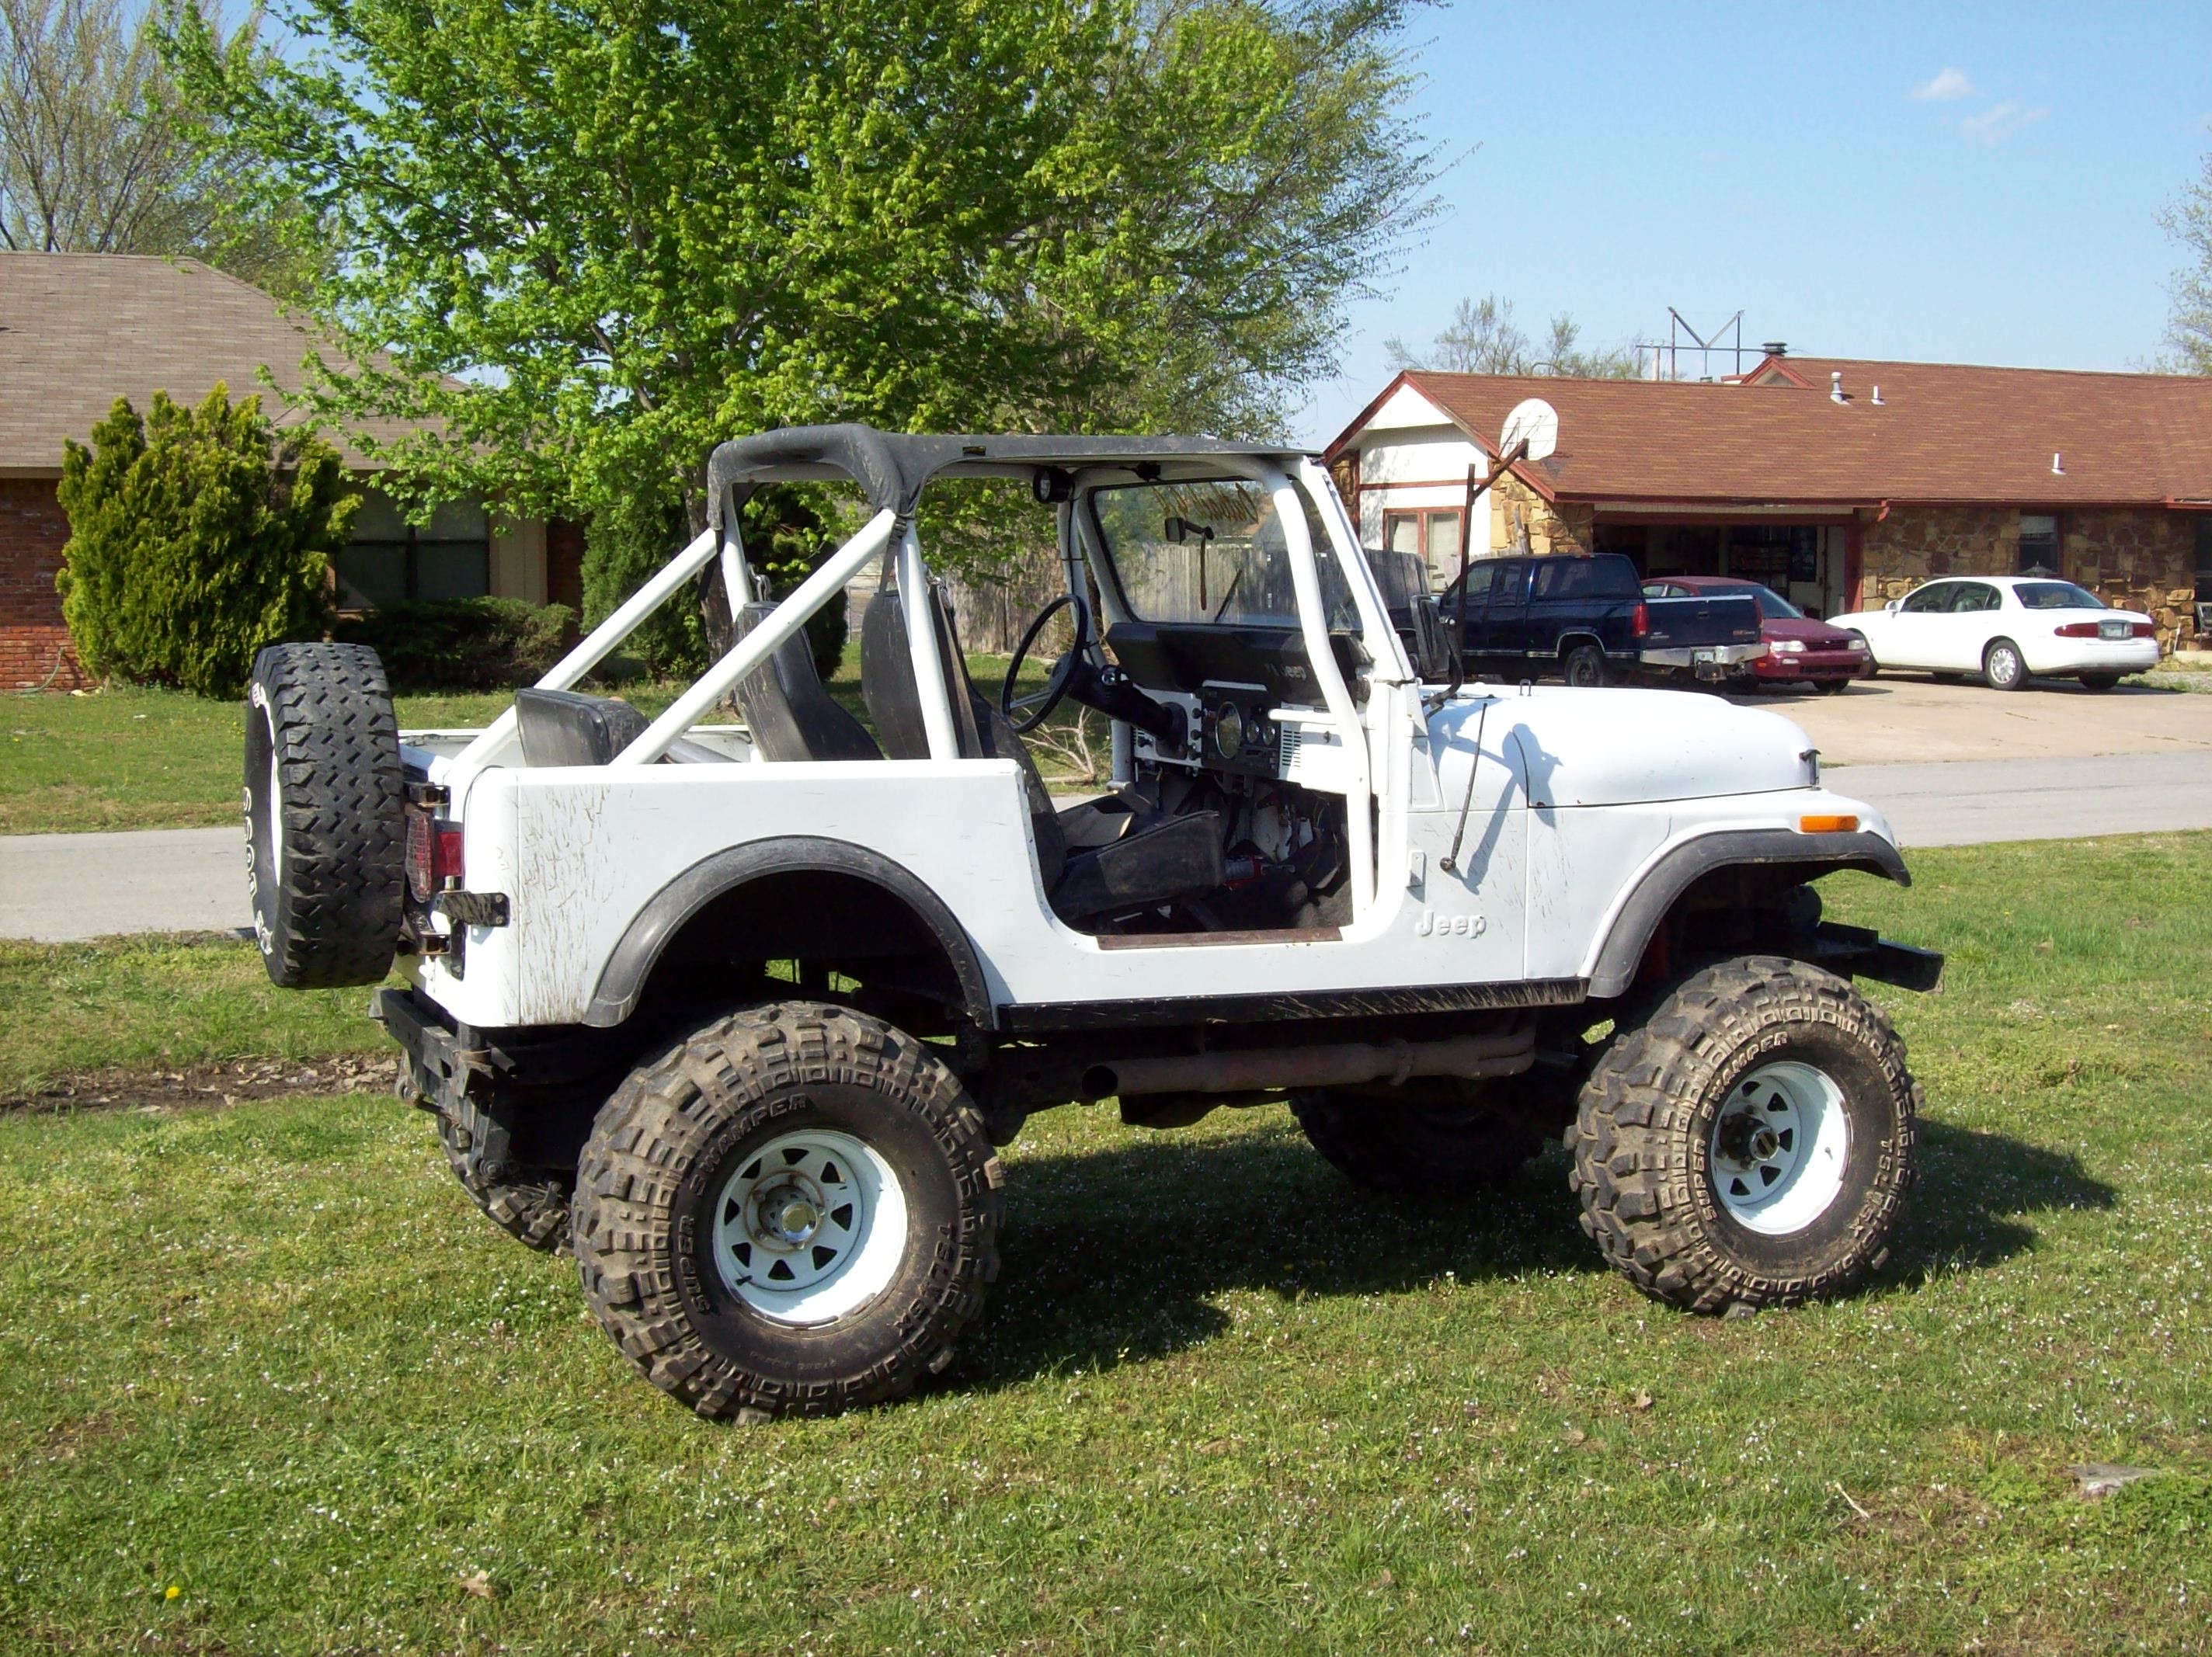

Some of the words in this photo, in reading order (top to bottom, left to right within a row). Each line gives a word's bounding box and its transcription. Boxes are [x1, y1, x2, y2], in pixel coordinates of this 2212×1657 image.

[1415, 910, 1487, 939] Jeep
[1701, 1031, 1788, 1121] SWAMPER
[689, 1093, 807, 1197] SWAMPER
[1693, 1138, 1718, 1221] SUPER
[678, 1214, 711, 1312] SUPER
